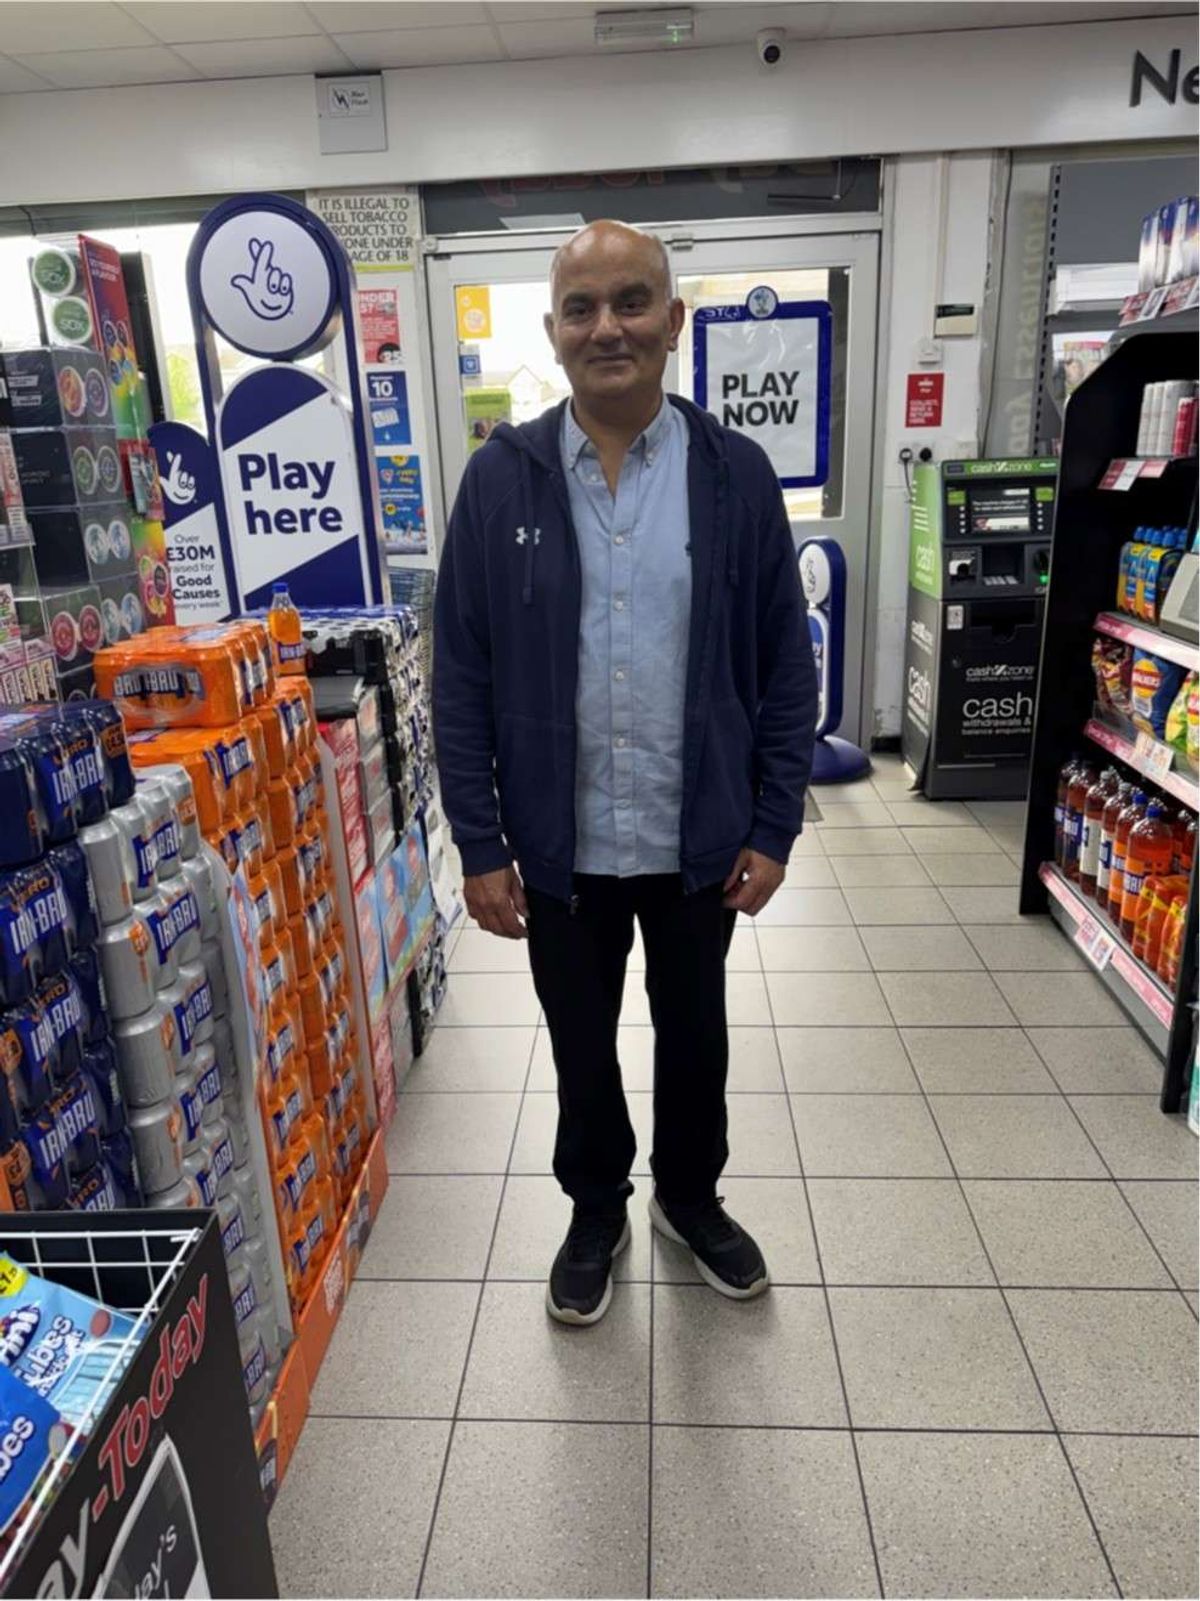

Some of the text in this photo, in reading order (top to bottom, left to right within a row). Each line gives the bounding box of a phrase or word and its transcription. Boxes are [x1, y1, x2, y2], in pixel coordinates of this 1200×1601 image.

[319, 197, 410, 210] IT IS ILLEGAL TO
[322, 211, 408, 223] SELL TOBACCO
[332, 224, 407, 236] RODUCTS TO
[344, 237, 413, 249] ONE UNDER
[376, 250, 390, 262] OF
[396, 250, 409, 261] 18
[371, 381, 393, 397] 10
[722, 371, 800, 399] PLAY
[722, 400, 799, 427] NOW
[237, 452, 336, 500] Play
[244, 500, 343, 535] here
[174, 534, 200, 544] Over
[170, 562, 215, 573] aised for
[176, 574, 213, 587] Good
[171, 588, 221, 600] Causes
[963, 692, 1033, 718] cash
[10, 887, 67, 955] IRN-BRU
[30, 990, 81, 1062] IRN-BRU
[39, 1088, 96, 1170] IRN-BRU
[14, 1314, 73, 1389] ubes
